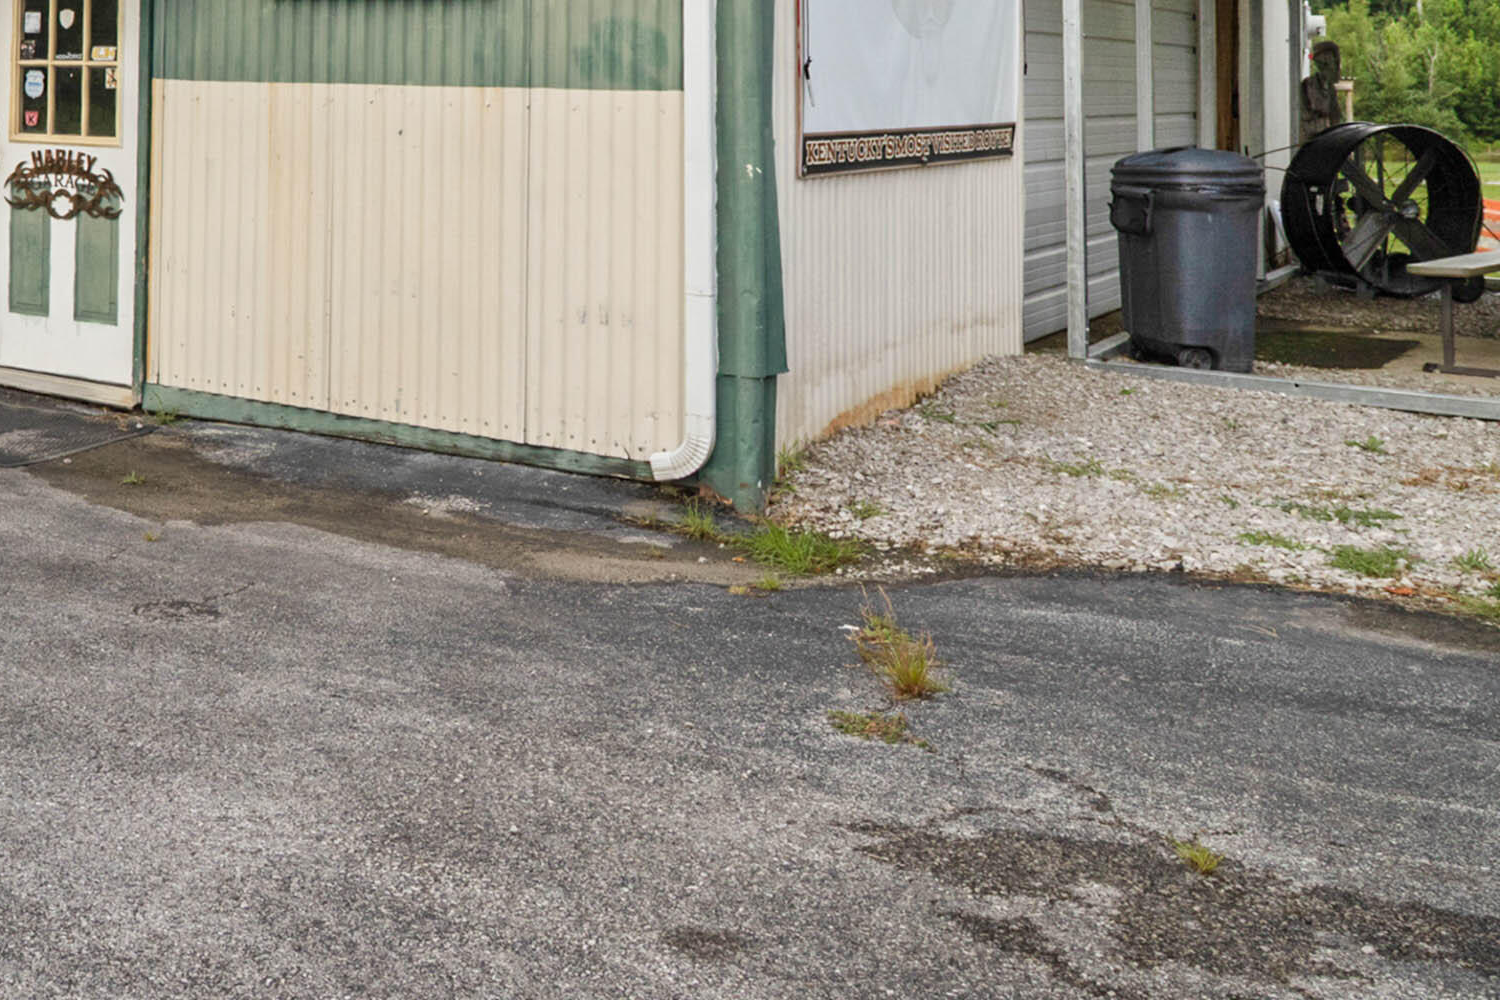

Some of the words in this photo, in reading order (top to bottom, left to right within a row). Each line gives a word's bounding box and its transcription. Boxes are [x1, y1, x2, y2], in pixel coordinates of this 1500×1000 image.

[31, 149, 97, 172] HARLEY
[806, 134, 894, 165] KENTUCKY'S
[894, 133, 930, 158] MOST
[932, 131, 975, 155] VISITED
